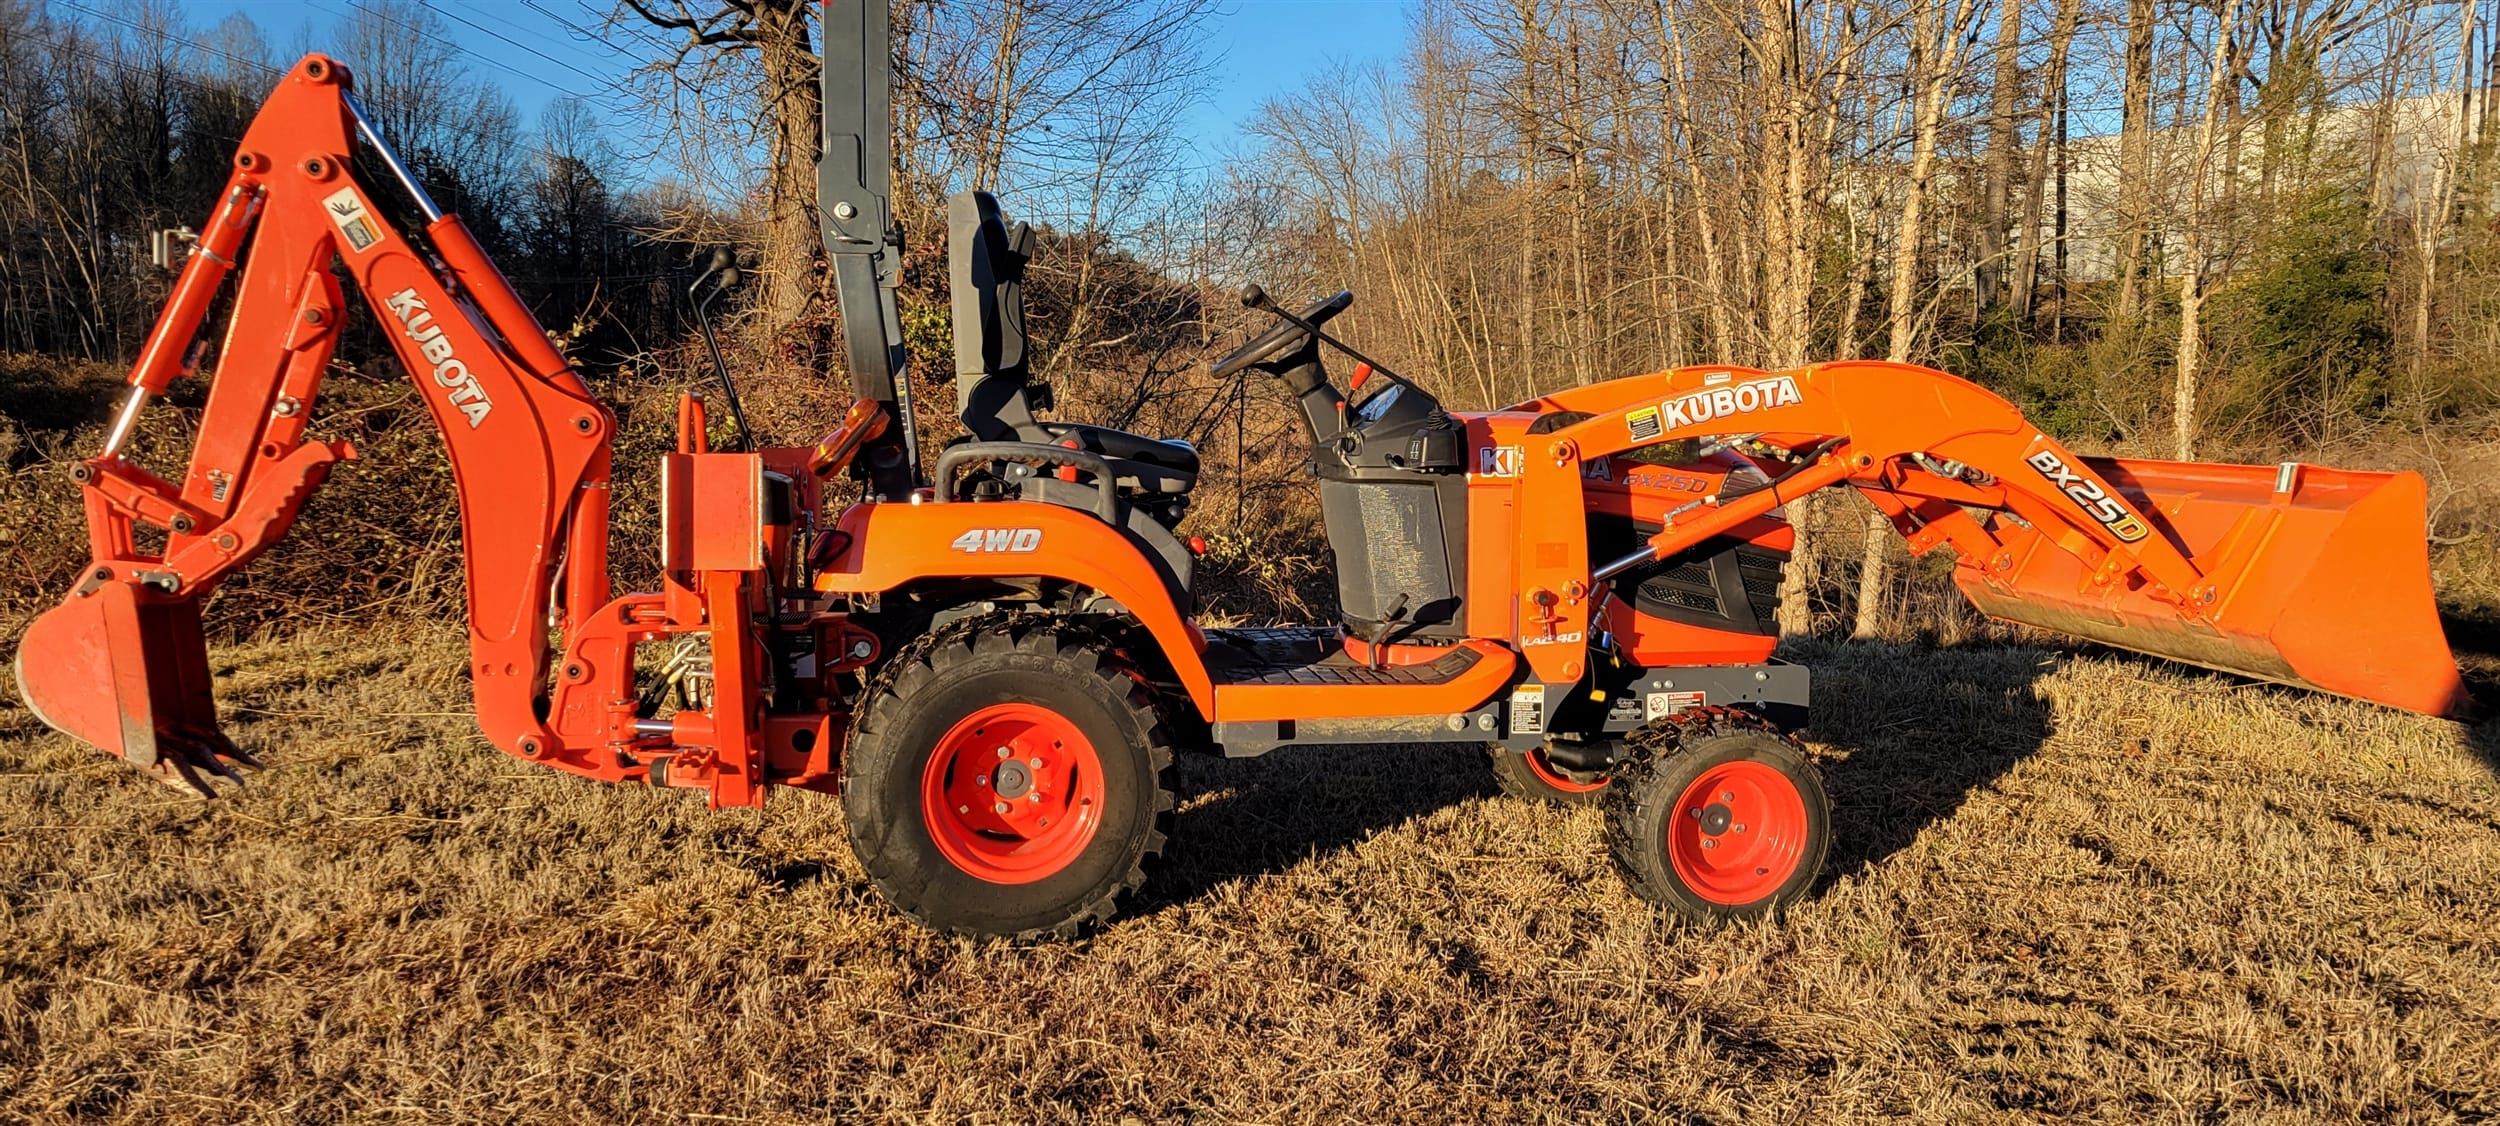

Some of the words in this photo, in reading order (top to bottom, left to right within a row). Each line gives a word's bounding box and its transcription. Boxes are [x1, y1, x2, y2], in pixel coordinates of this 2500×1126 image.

[387, 288, 493, 428] KUBOTA
[1663, 377, 1801, 431] KUBOTA
[1622, 473, 1708, 493] BX25D
[2028, 450, 2148, 541] BX25D
[951, 528, 1042, 553] 4WD
